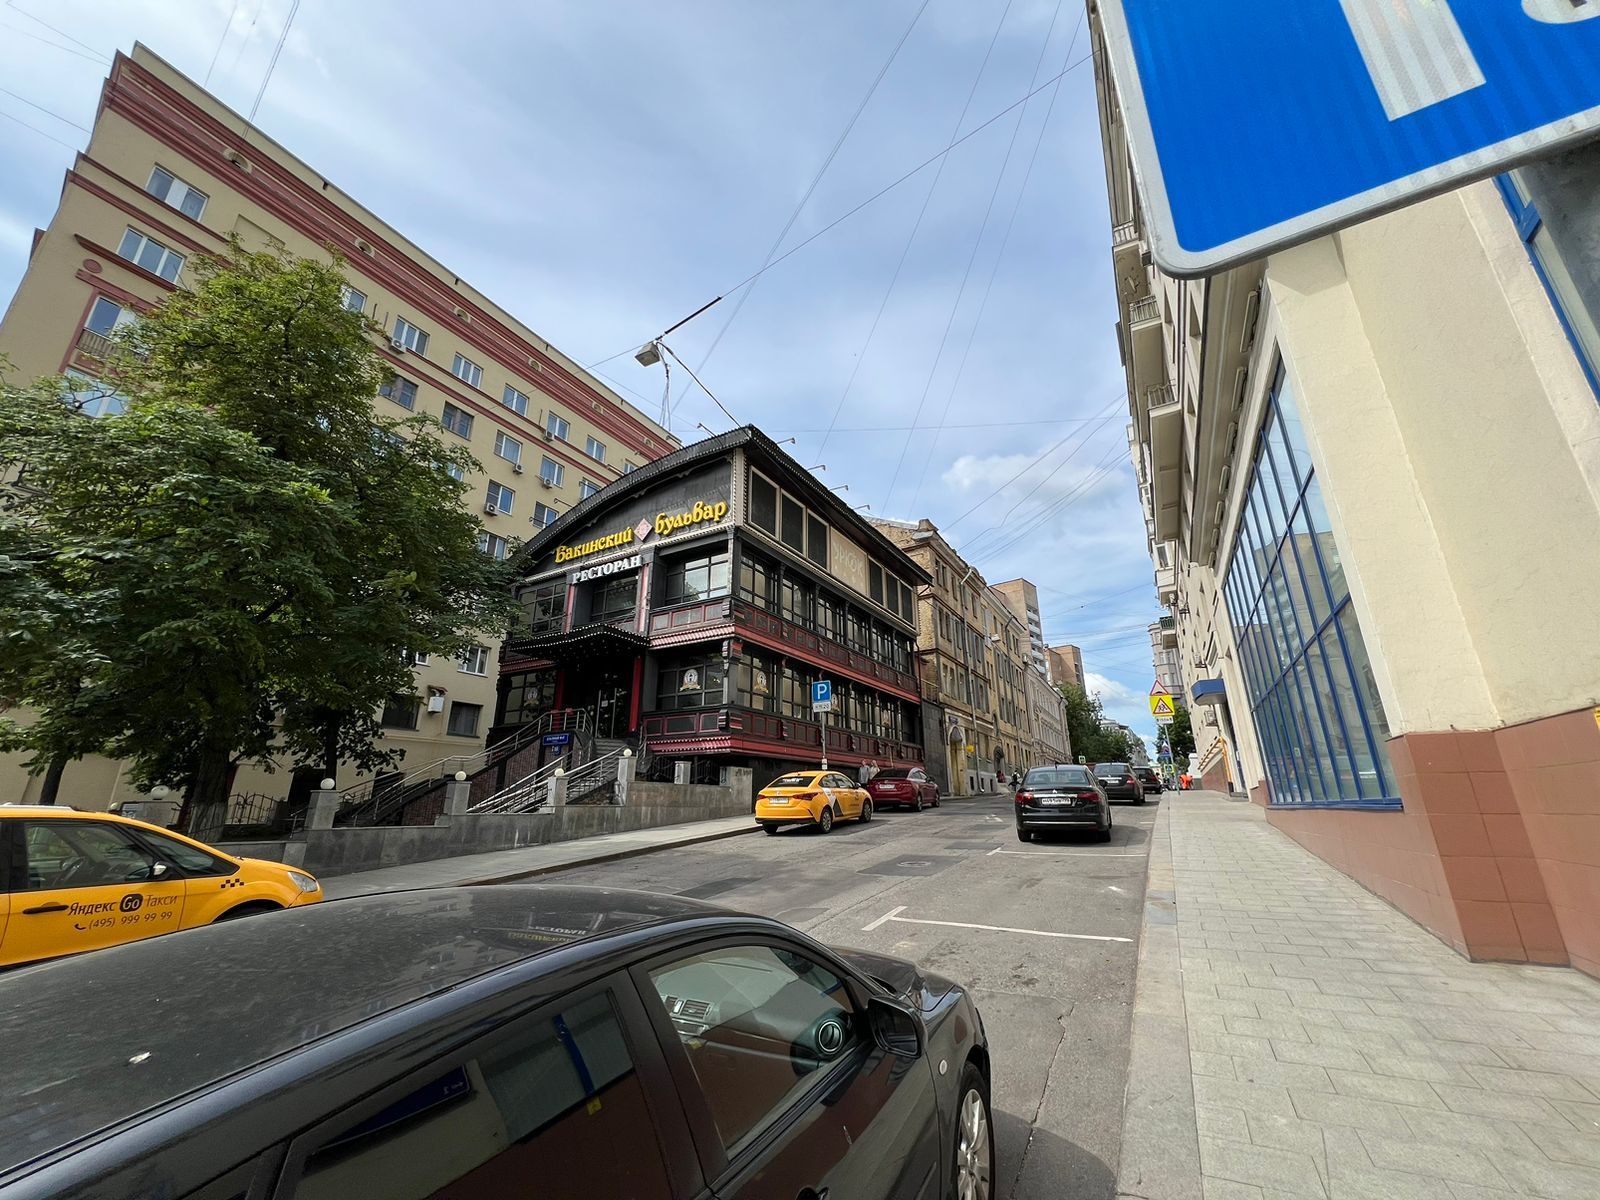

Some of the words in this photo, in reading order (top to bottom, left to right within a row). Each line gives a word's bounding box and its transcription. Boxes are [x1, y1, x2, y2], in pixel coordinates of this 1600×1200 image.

[572, 555, 643, 584] РЕСТОРАН
[817, 683, 828, 700] P
[68, 901, 117, 916] Яндекс
[121, 895, 141, 911] Go
[146, 895, 178, 907] Такси
[89, 917, 116, 930] (495)
[121, 914, 140, 925] 999
[144, 912, 157, 922] 99
[160, 911, 173, 920] 99
